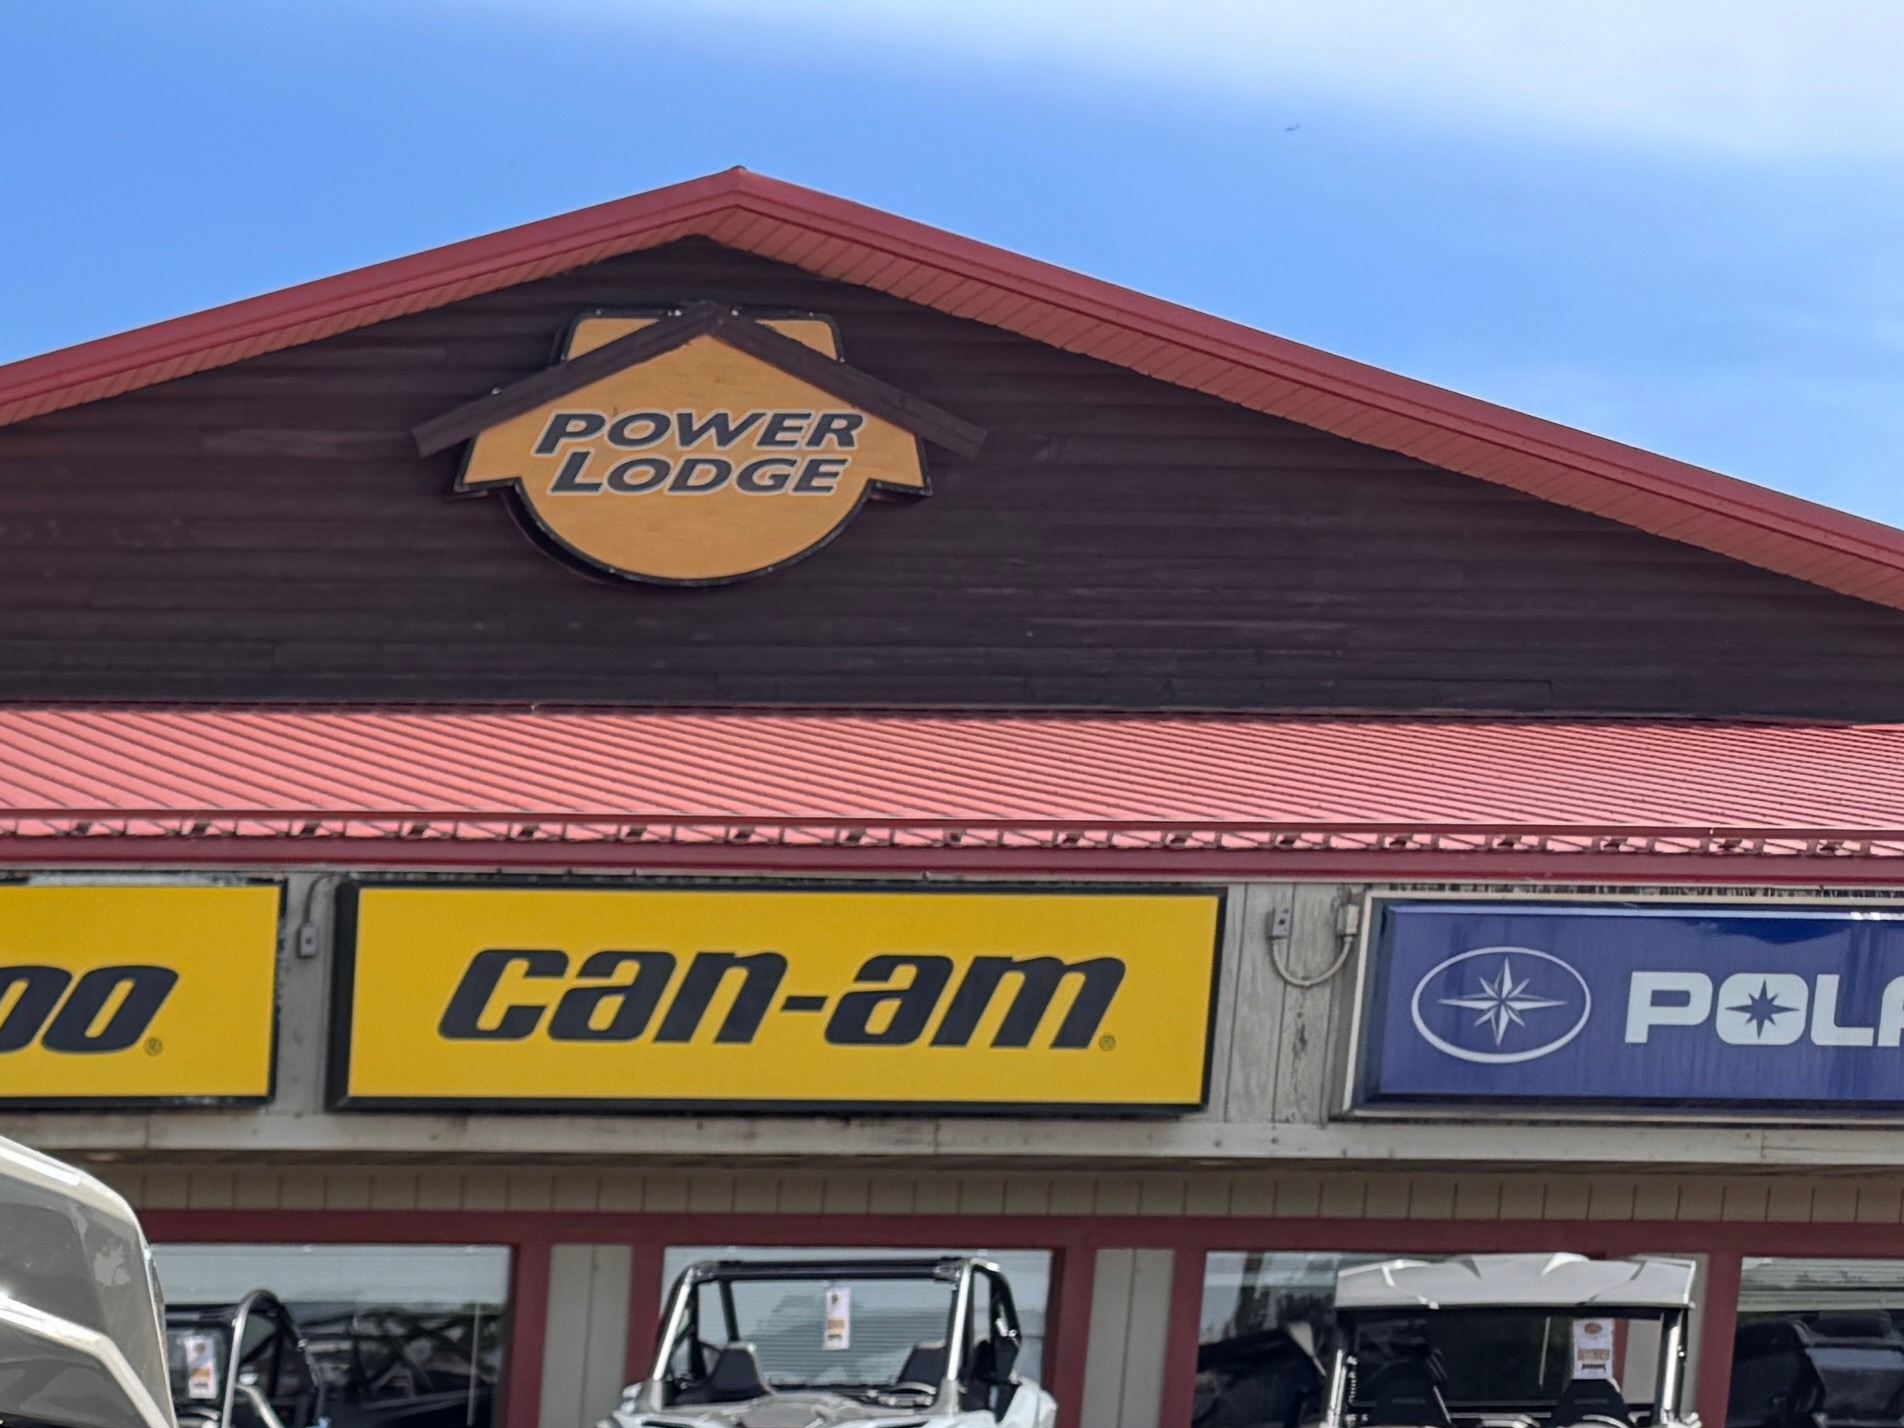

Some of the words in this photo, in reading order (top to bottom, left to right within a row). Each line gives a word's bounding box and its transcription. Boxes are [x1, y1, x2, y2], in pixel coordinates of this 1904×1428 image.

[535, 411, 864, 455] POWER
[550, 451, 848, 493] LODGE
[437, 949, 1126, 1049] can-am
